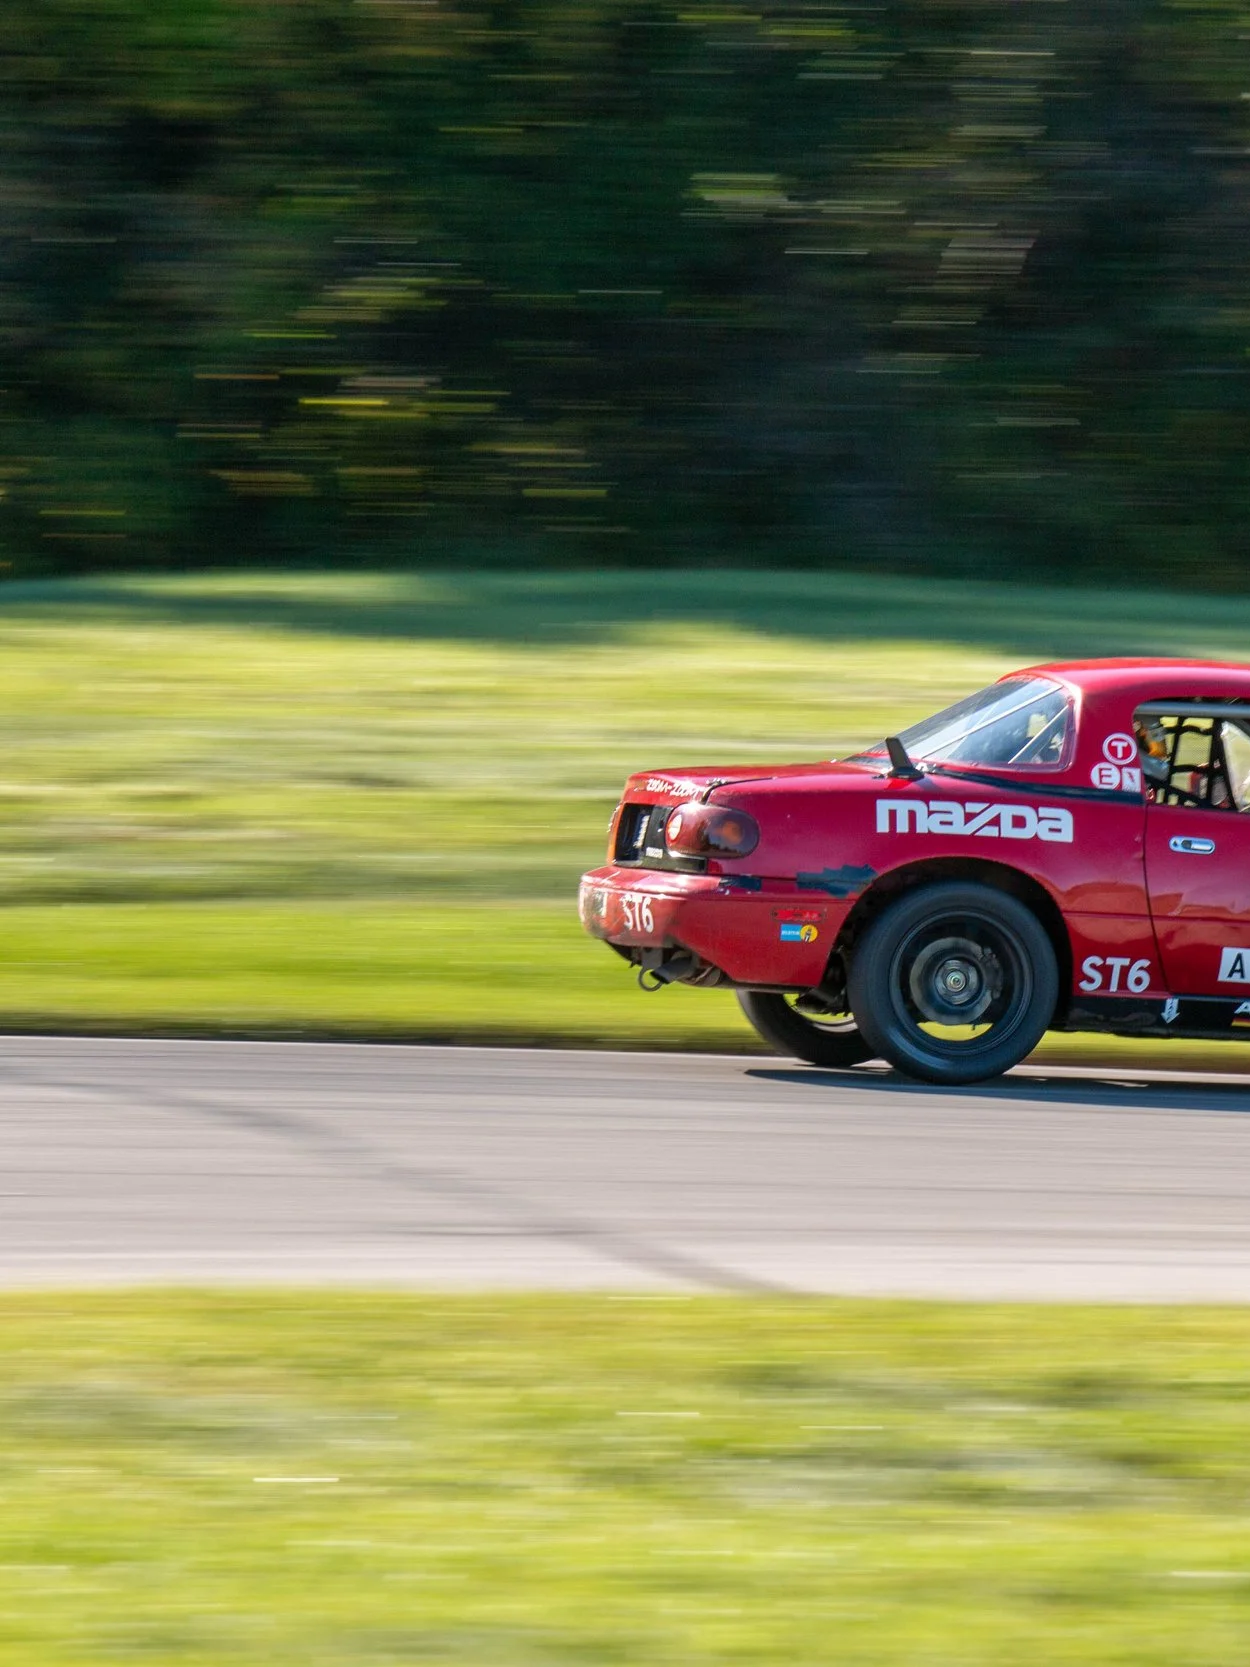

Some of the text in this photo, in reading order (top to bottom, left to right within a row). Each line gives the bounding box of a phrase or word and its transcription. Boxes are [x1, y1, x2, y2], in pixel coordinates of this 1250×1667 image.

[1111, 740, 1128, 758] T
[619, 893, 654, 932] ST6
[1078, 956, 1151, 994] ST6
[1226, 952, 1246, 978] A
